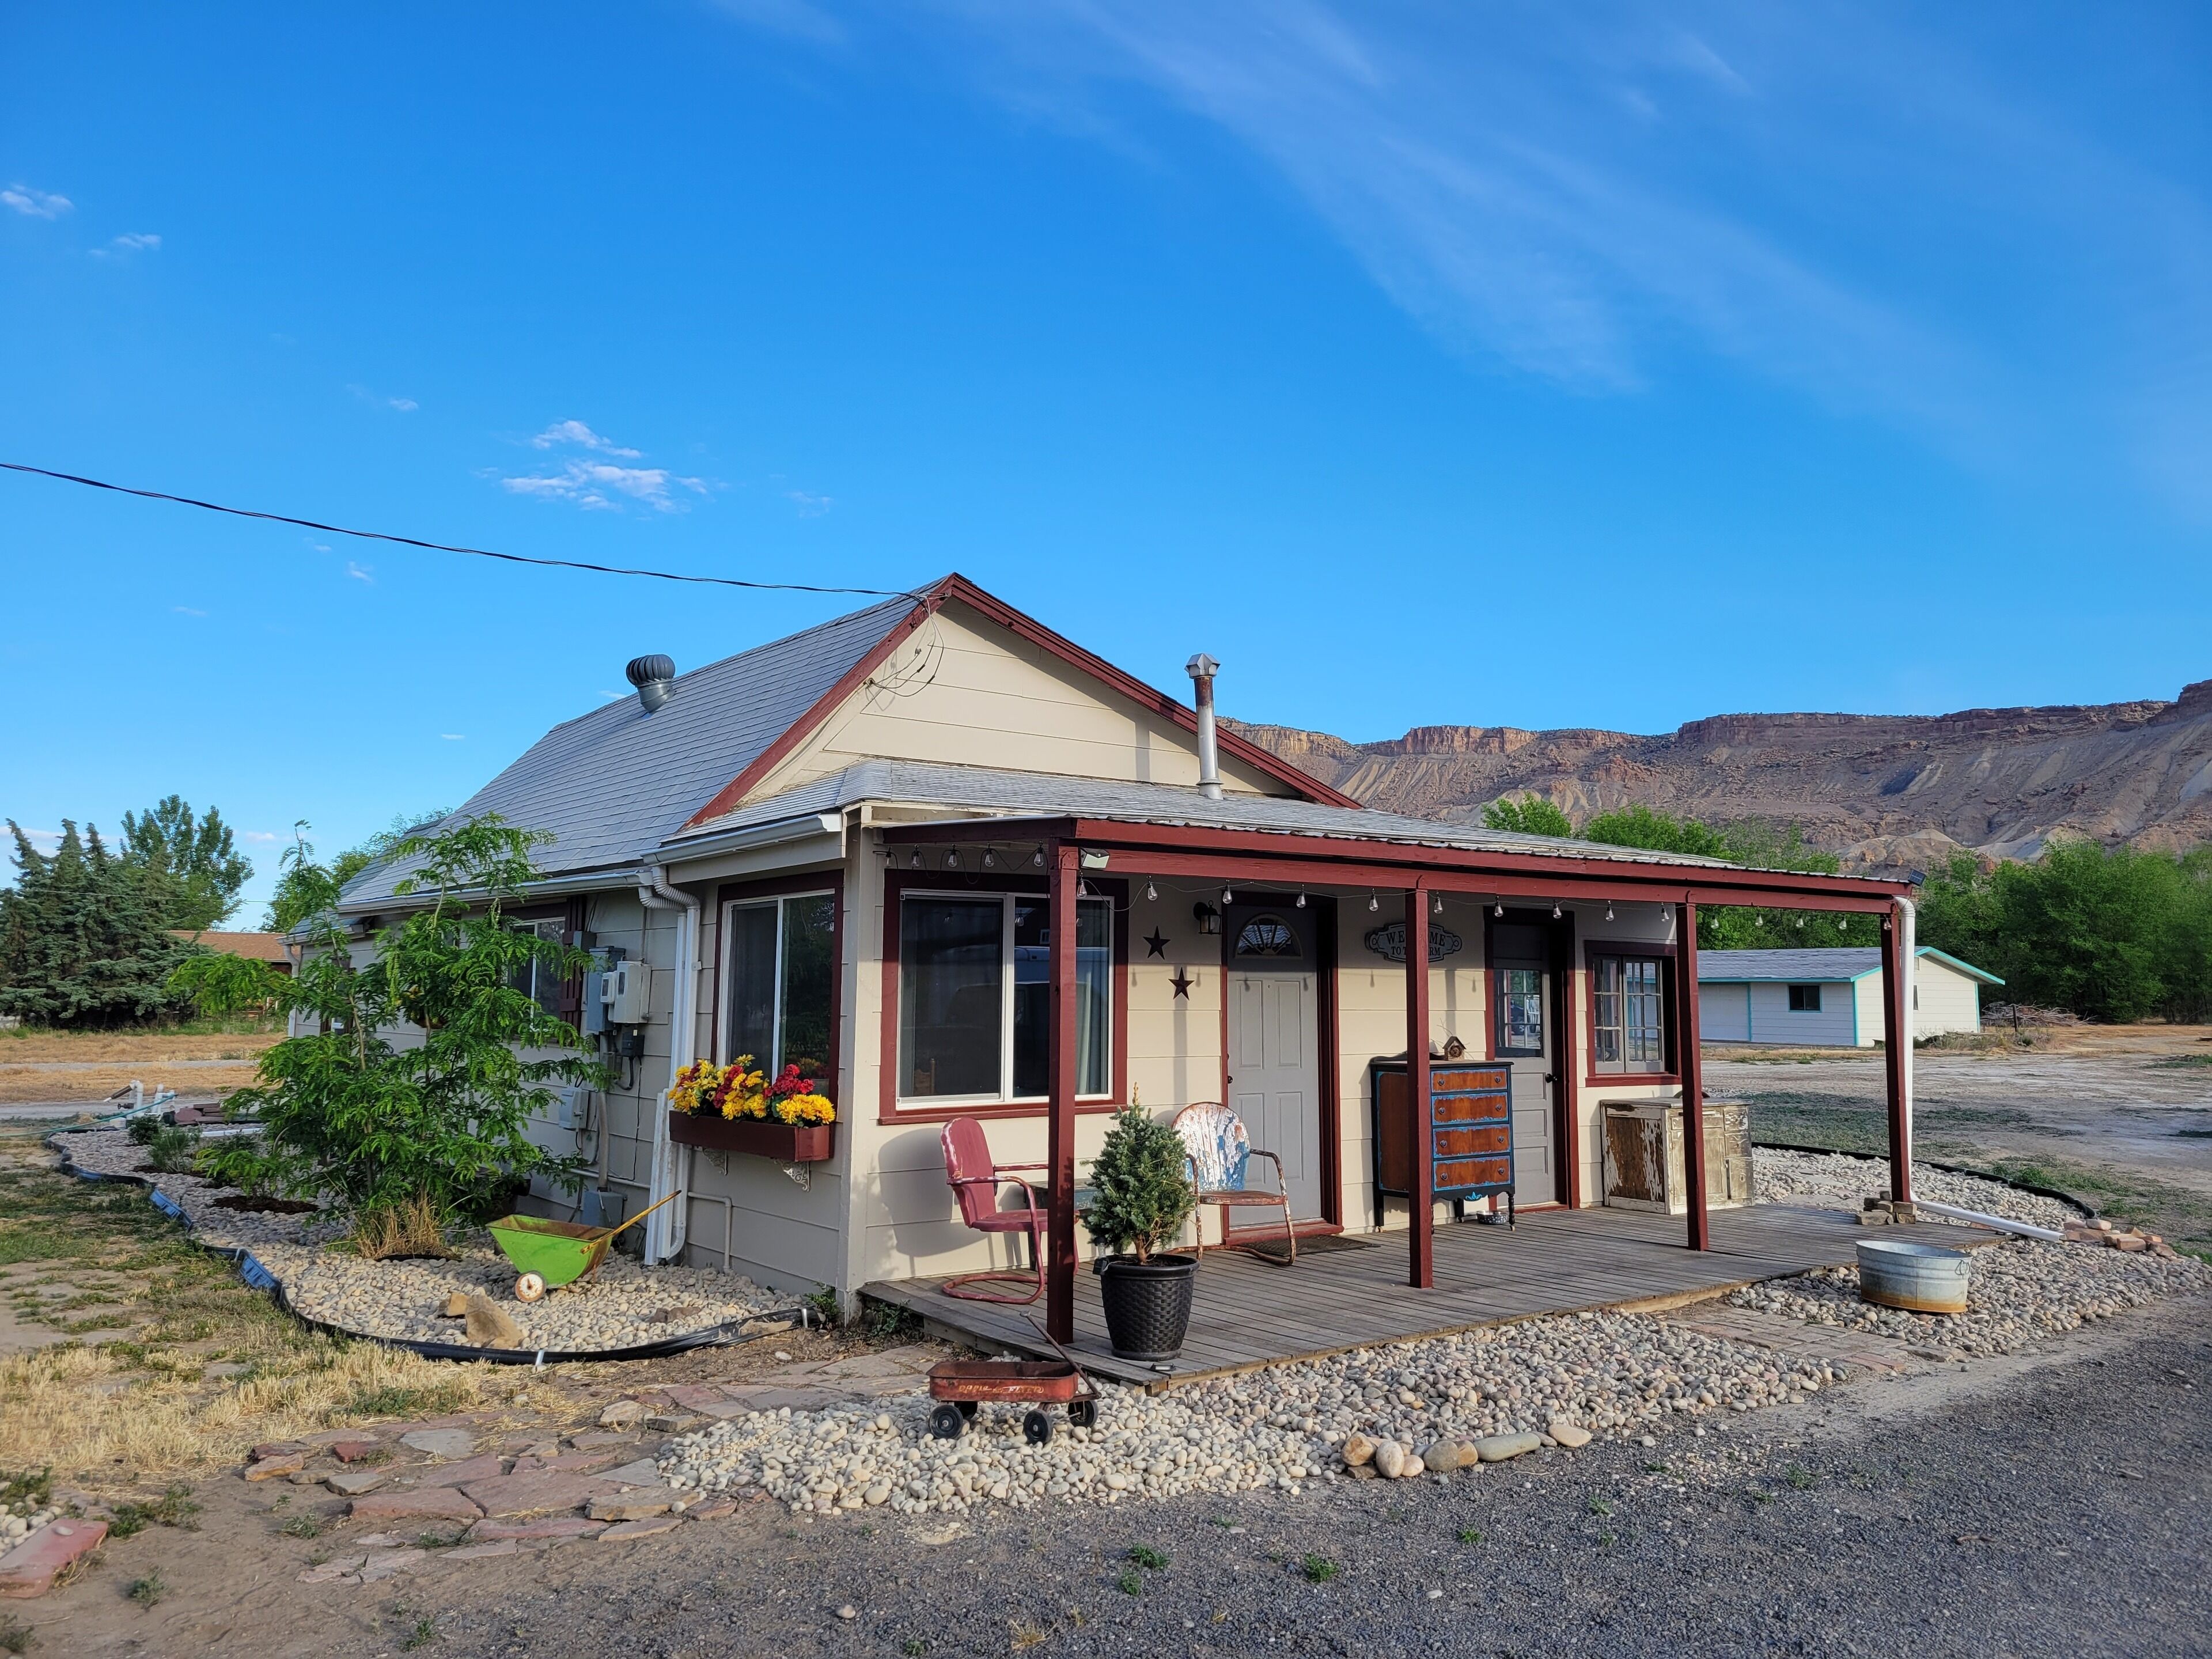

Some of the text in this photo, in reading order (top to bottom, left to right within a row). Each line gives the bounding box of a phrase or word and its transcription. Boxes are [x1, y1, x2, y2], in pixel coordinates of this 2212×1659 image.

[1387, 931, 1445, 946] WEME
[1391, 946, 1401, 955] TO
[1429, 946, 1440, 956] RM
